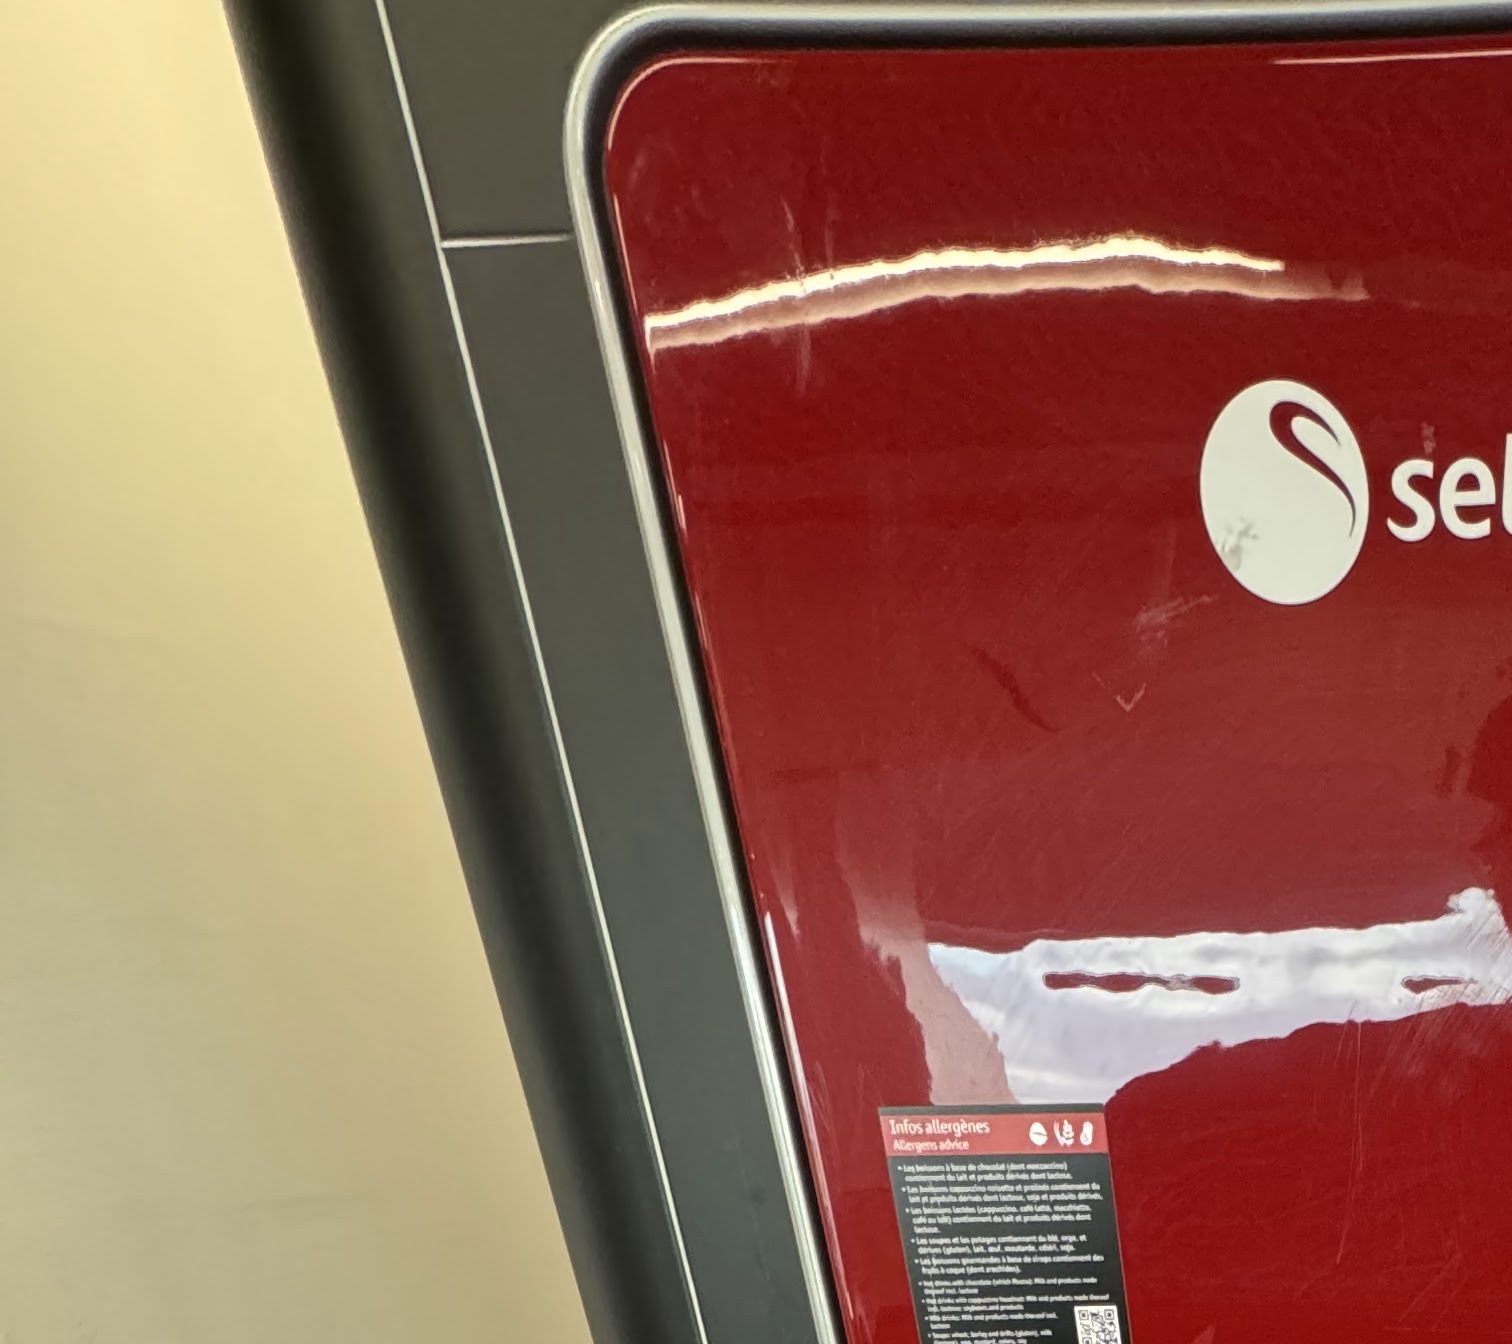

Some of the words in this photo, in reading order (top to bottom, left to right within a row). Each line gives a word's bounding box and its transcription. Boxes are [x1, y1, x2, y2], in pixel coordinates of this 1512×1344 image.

[890, 1119, 923, 1135] Infos
[925, 1118, 990, 1138] allergènes
[893, 1139, 938, 1153] Allergens
[939, 1138, 970, 1151] advice
